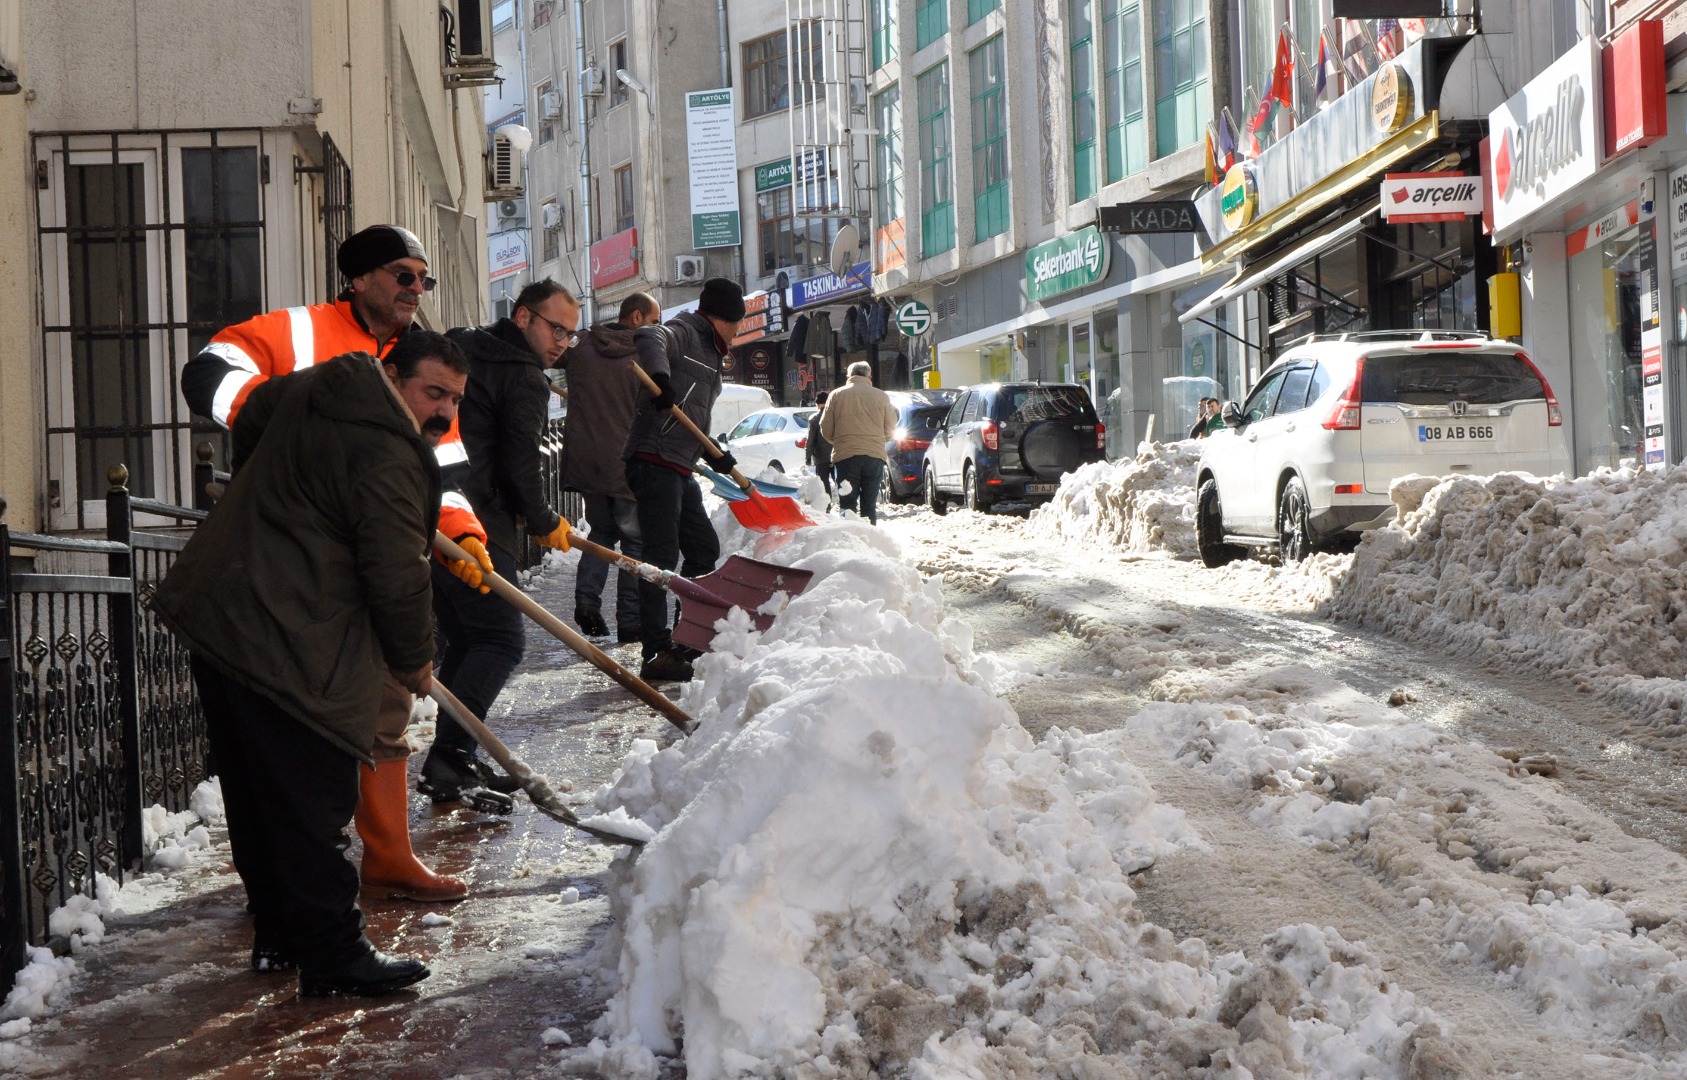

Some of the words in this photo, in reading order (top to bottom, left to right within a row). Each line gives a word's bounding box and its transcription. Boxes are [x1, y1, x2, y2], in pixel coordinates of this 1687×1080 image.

[702, 94, 730, 102] ARTÖLYE
[1515, 72, 1584, 201] arçelik
[768, 164, 793, 178] ARTÖLY
[1412, 183, 1476, 206] arçelik
[1130, 207, 1193, 229] KADA
[1033, 239, 1085, 291] Şekerbank
[1644, 361, 1661, 373] Lenovo
[1646, 374, 1659, 384] oppo
[1425, 427, 1442, 440] 08
[1446, 426, 1465, 439] AB
[1469, 426, 1493, 439] 666
